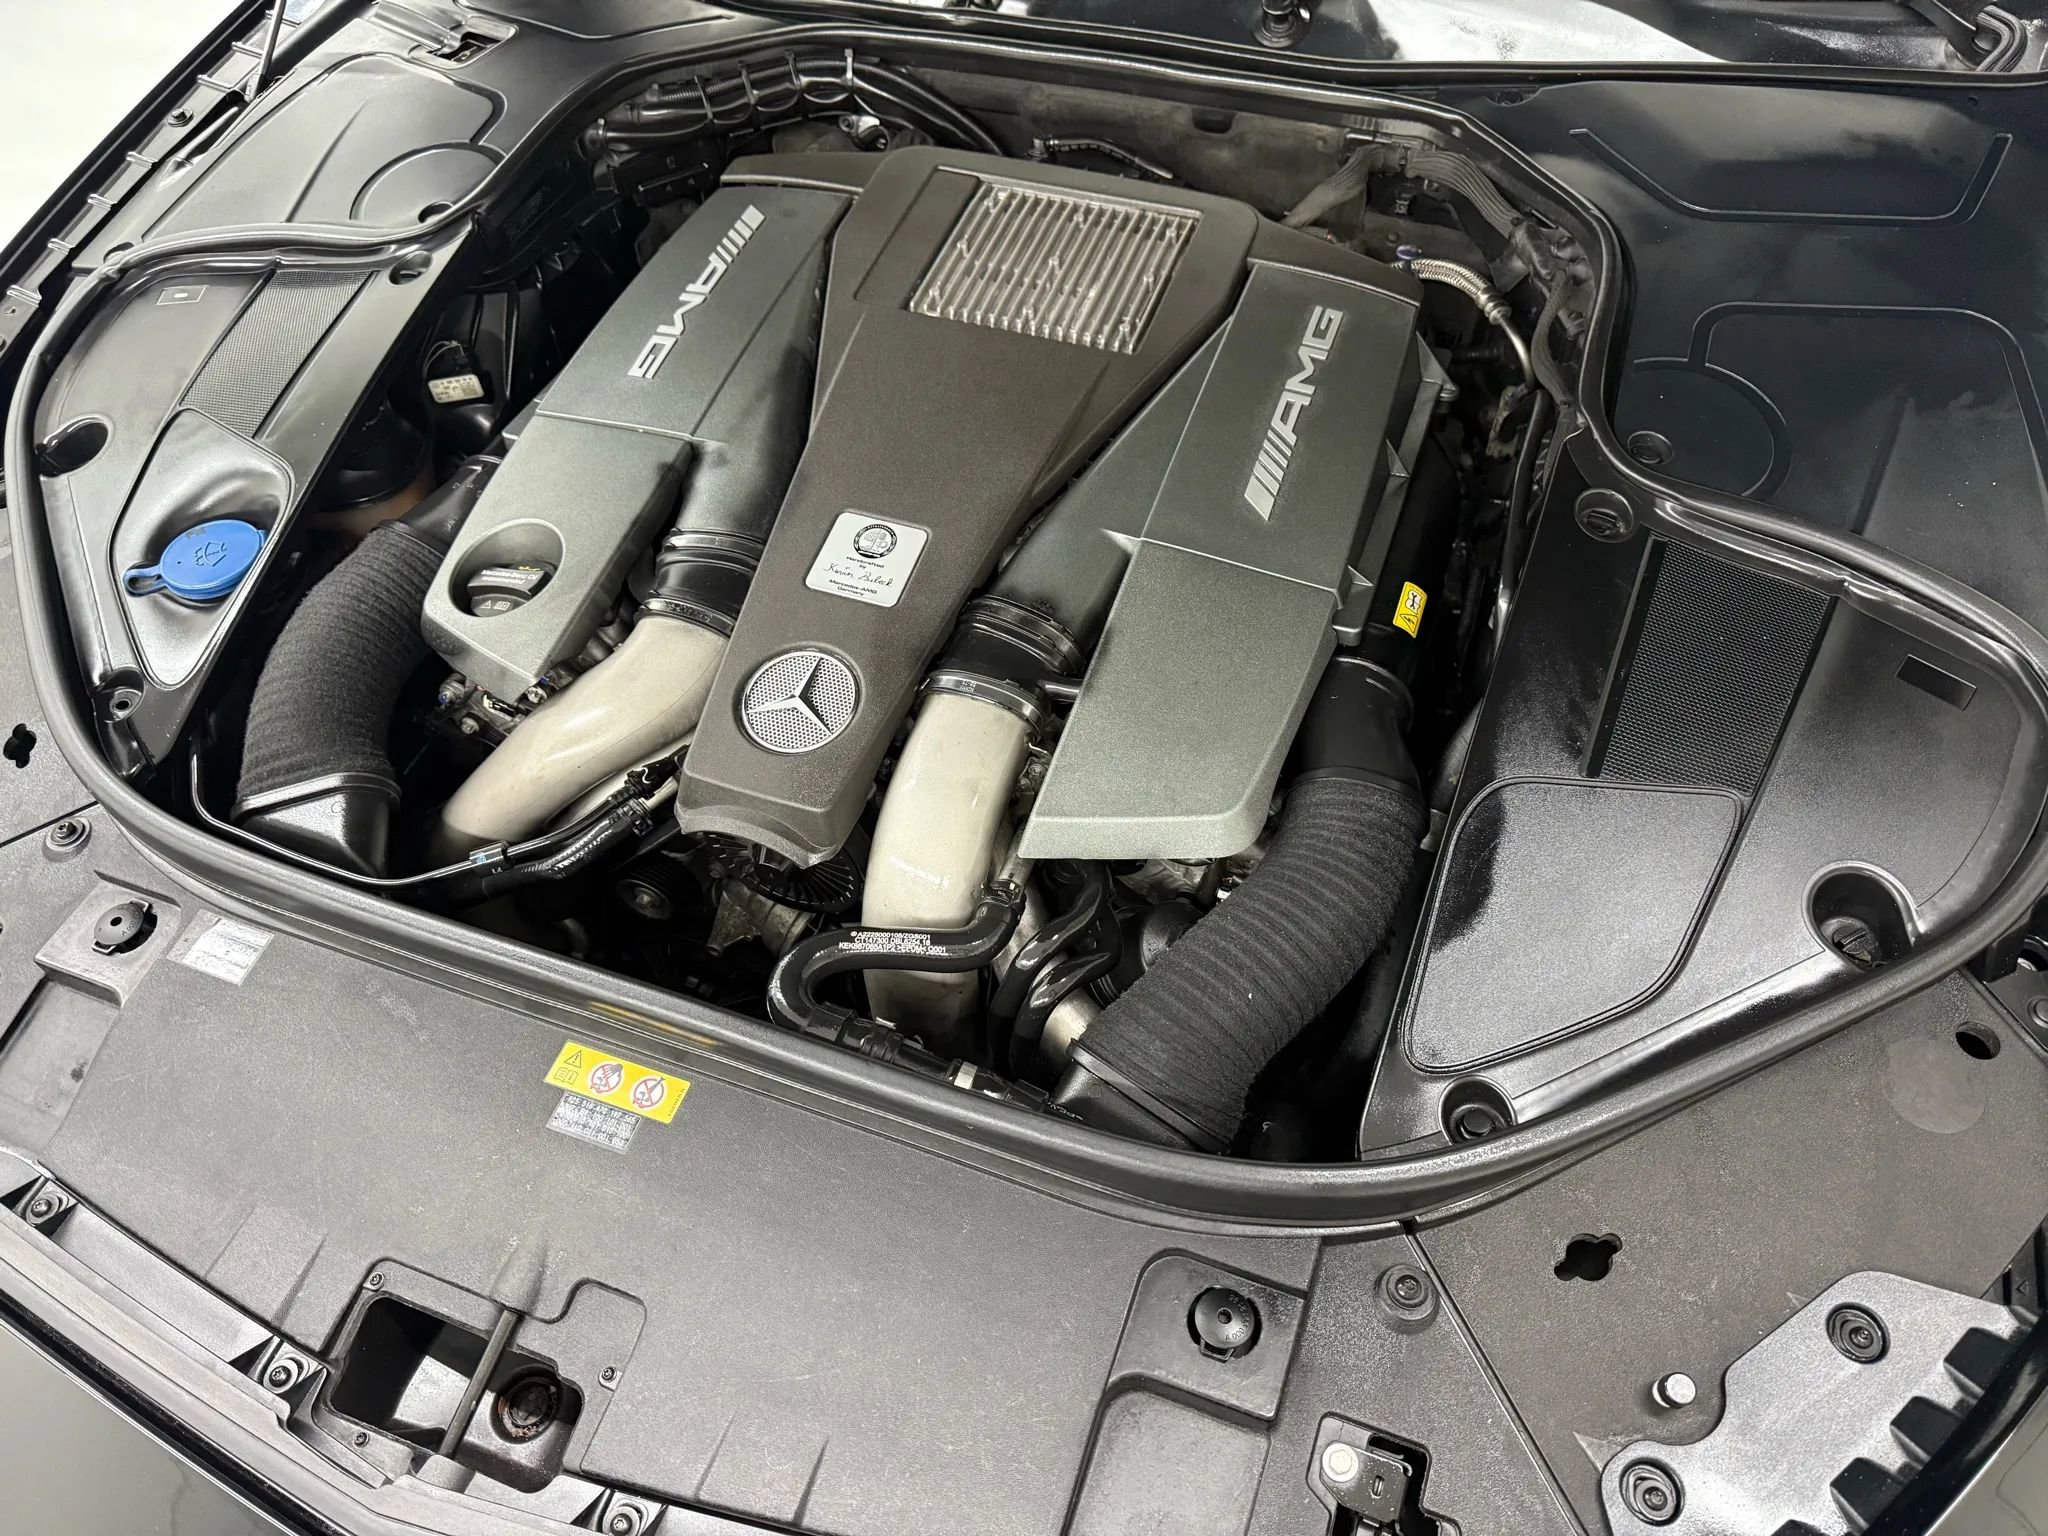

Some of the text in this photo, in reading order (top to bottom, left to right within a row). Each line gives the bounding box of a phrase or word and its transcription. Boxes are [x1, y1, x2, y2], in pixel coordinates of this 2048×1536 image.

[627, 252, 728, 379] AMG
[1270, 305, 1344, 447] AMG
[837, 587, 865, 597] Germany
[846, 556, 885, 569] Handcrafted
